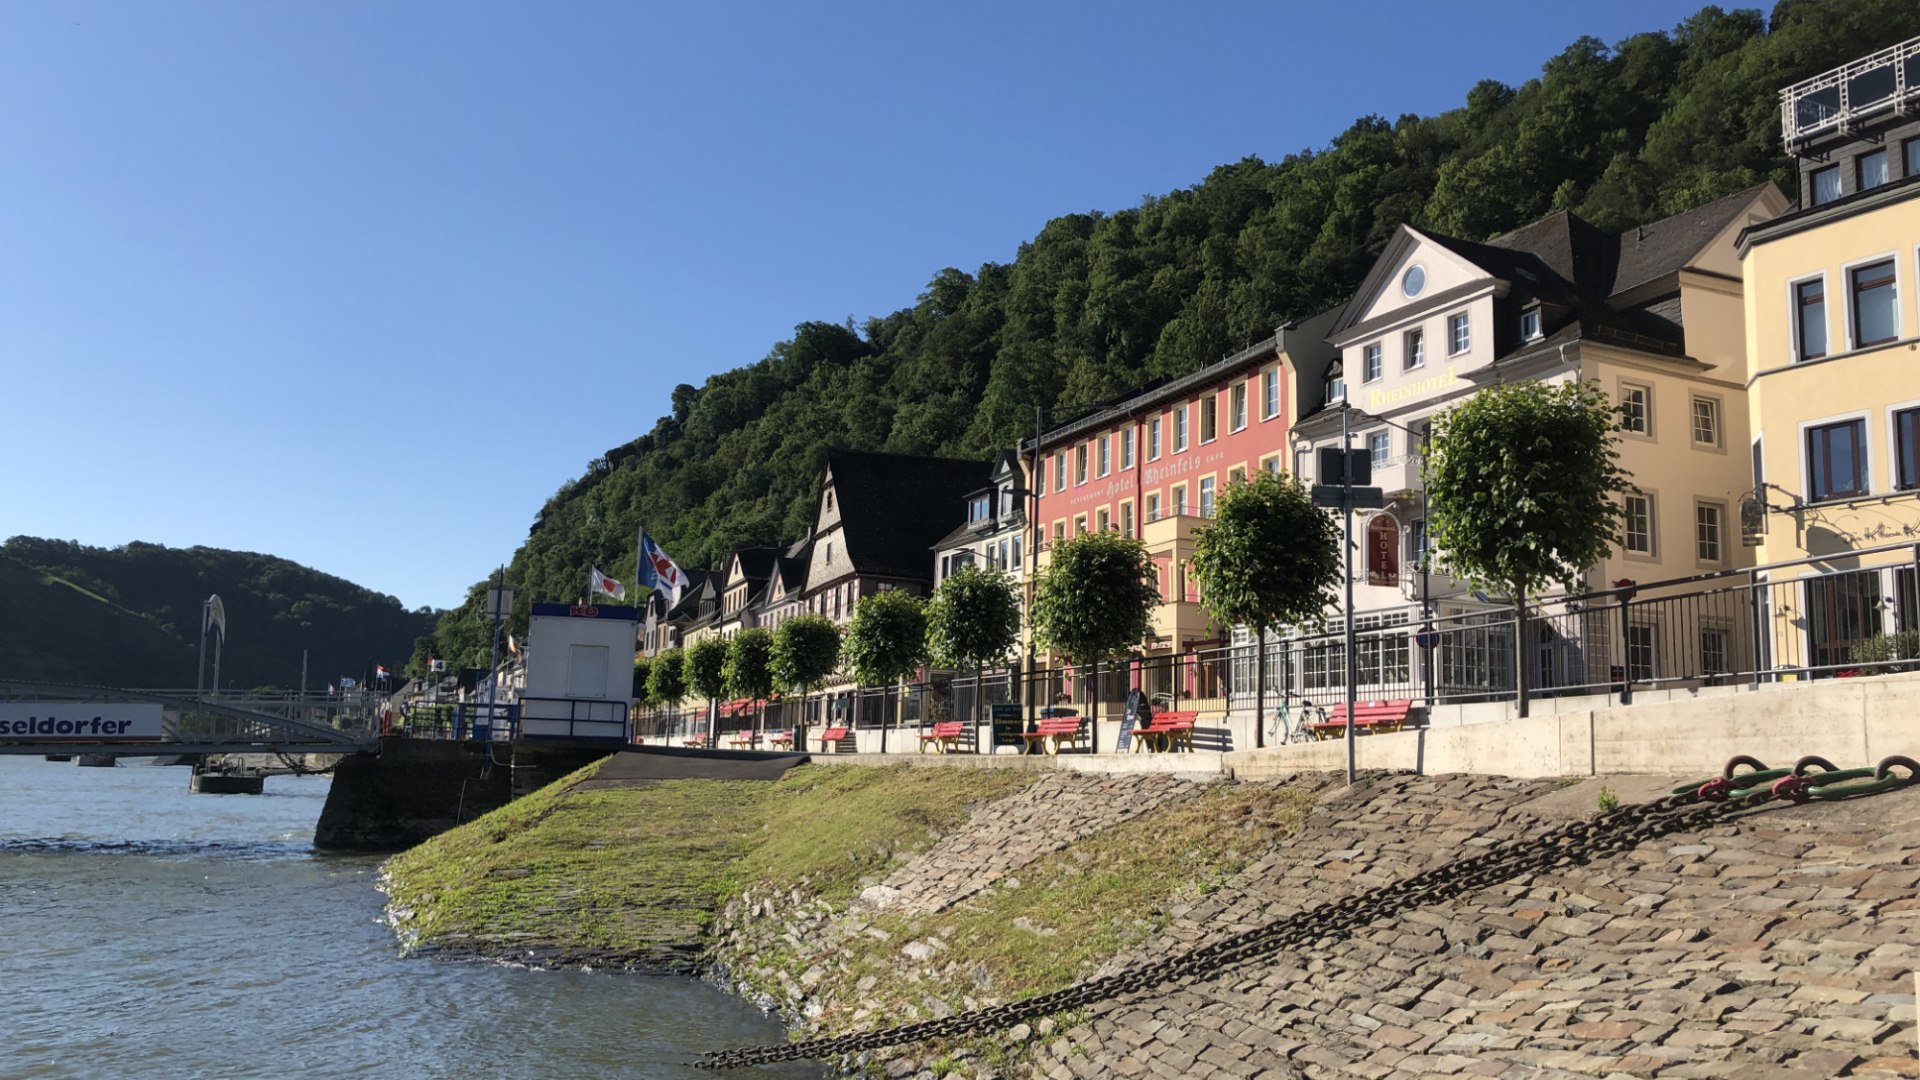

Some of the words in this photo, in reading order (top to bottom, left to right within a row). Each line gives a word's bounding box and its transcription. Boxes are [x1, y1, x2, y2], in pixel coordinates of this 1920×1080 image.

[1106, 476, 1135, 499] Hotel
[1144, 455, 1201, 485] Rheinfels
[1380, 531, 1388, 580] HOTEL
[570, 604, 599, 617] KD
[435, 661, 444, 670] 4
